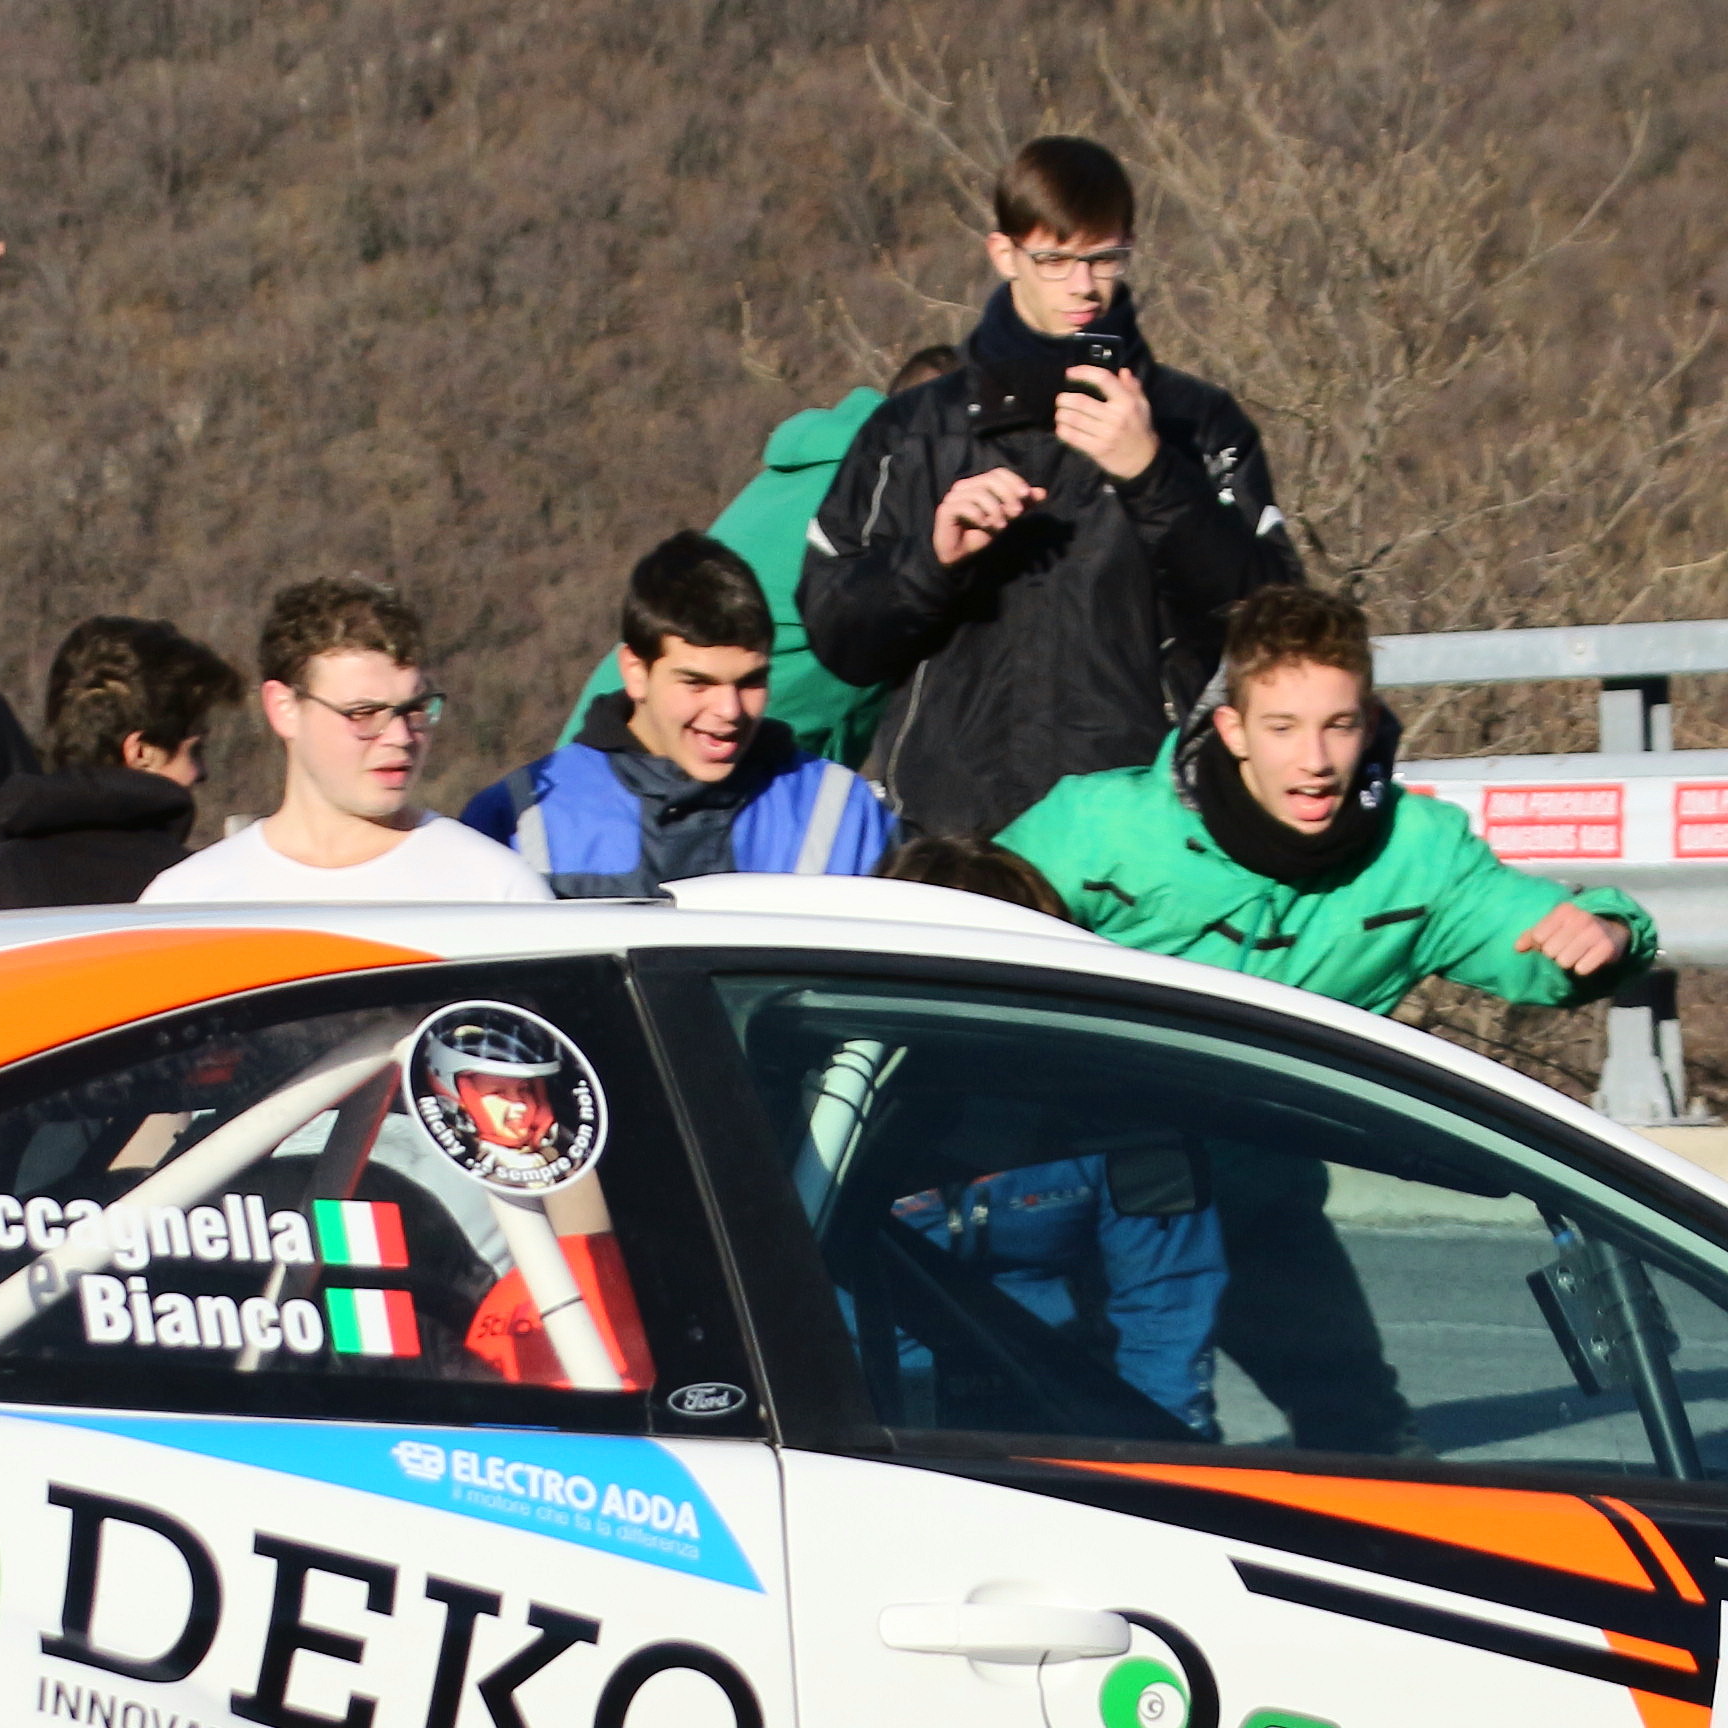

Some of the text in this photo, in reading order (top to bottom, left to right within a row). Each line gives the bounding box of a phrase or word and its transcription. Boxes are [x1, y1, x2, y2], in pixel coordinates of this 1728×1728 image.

[419, 1095, 467, 1157] Michy
[496, 1156, 572, 1182] sempre
[568, 1123, 594, 1159] con
[79, 1273, 325, 1354] Bianco
[684, 1386, 729, 1412] Ford
[450, 1449, 700, 1540] ELECTRO ADDA
[465, 1491, 532, 1517] motore
[536, 1503, 569, 1526] che
[574, 1512, 592, 1532] fa
[596, 1517, 613, 1537] la
[616, 1522, 700, 1561] differenza
